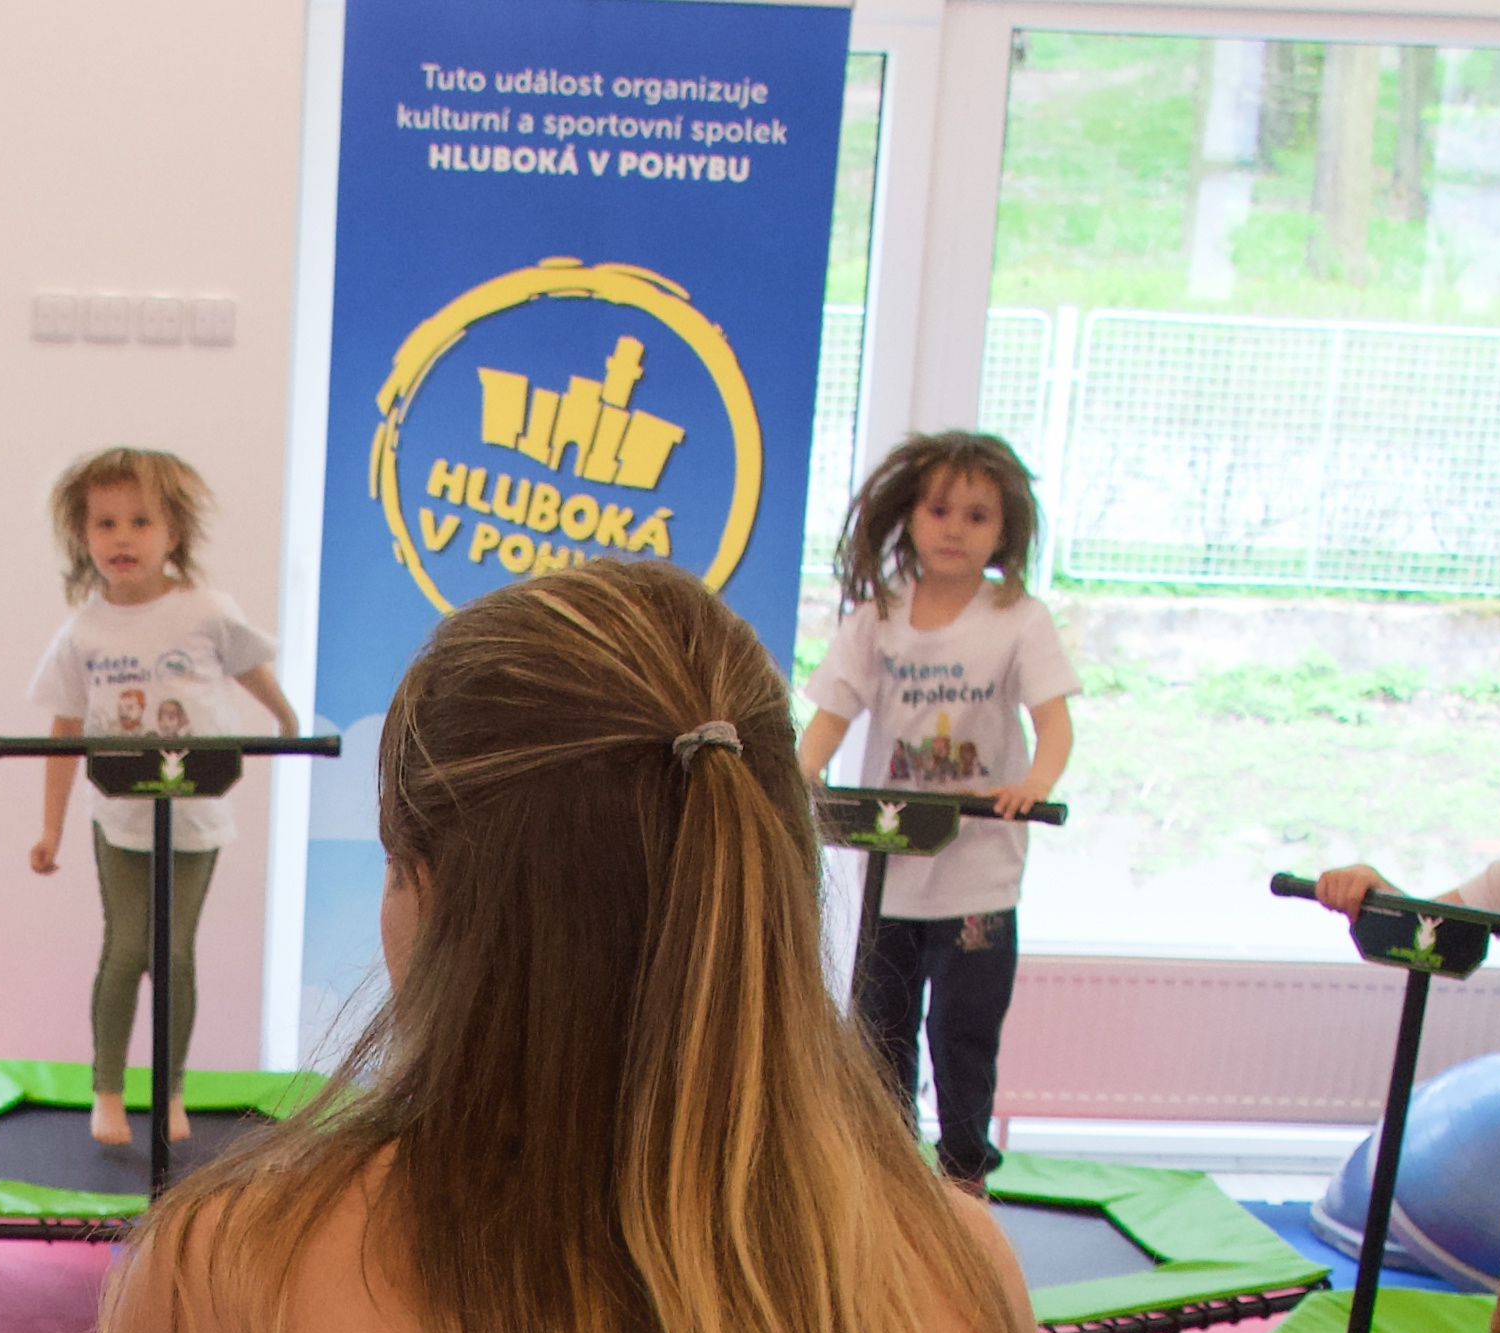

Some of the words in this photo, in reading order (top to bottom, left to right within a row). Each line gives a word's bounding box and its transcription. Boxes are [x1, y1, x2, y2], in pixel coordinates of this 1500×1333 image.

[421, 61, 487, 92] Tuto
[495, 67, 604, 97] událost
[612, 75, 769, 110] organizuje
[397, 102, 511, 133] kulturní
[518, 113, 534, 134] a
[544, 112, 685, 141] sportovní
[691, 117, 787, 148] spolek
[429, 141, 579, 176] HLUBOKÁ
[588, 149, 611, 177] V
[618, 150, 750, 183] POHYBU
[427, 457, 674, 558] HLUBOKÁ
[418, 506, 461, 553] V
[467, 521, 600, 578] POH
